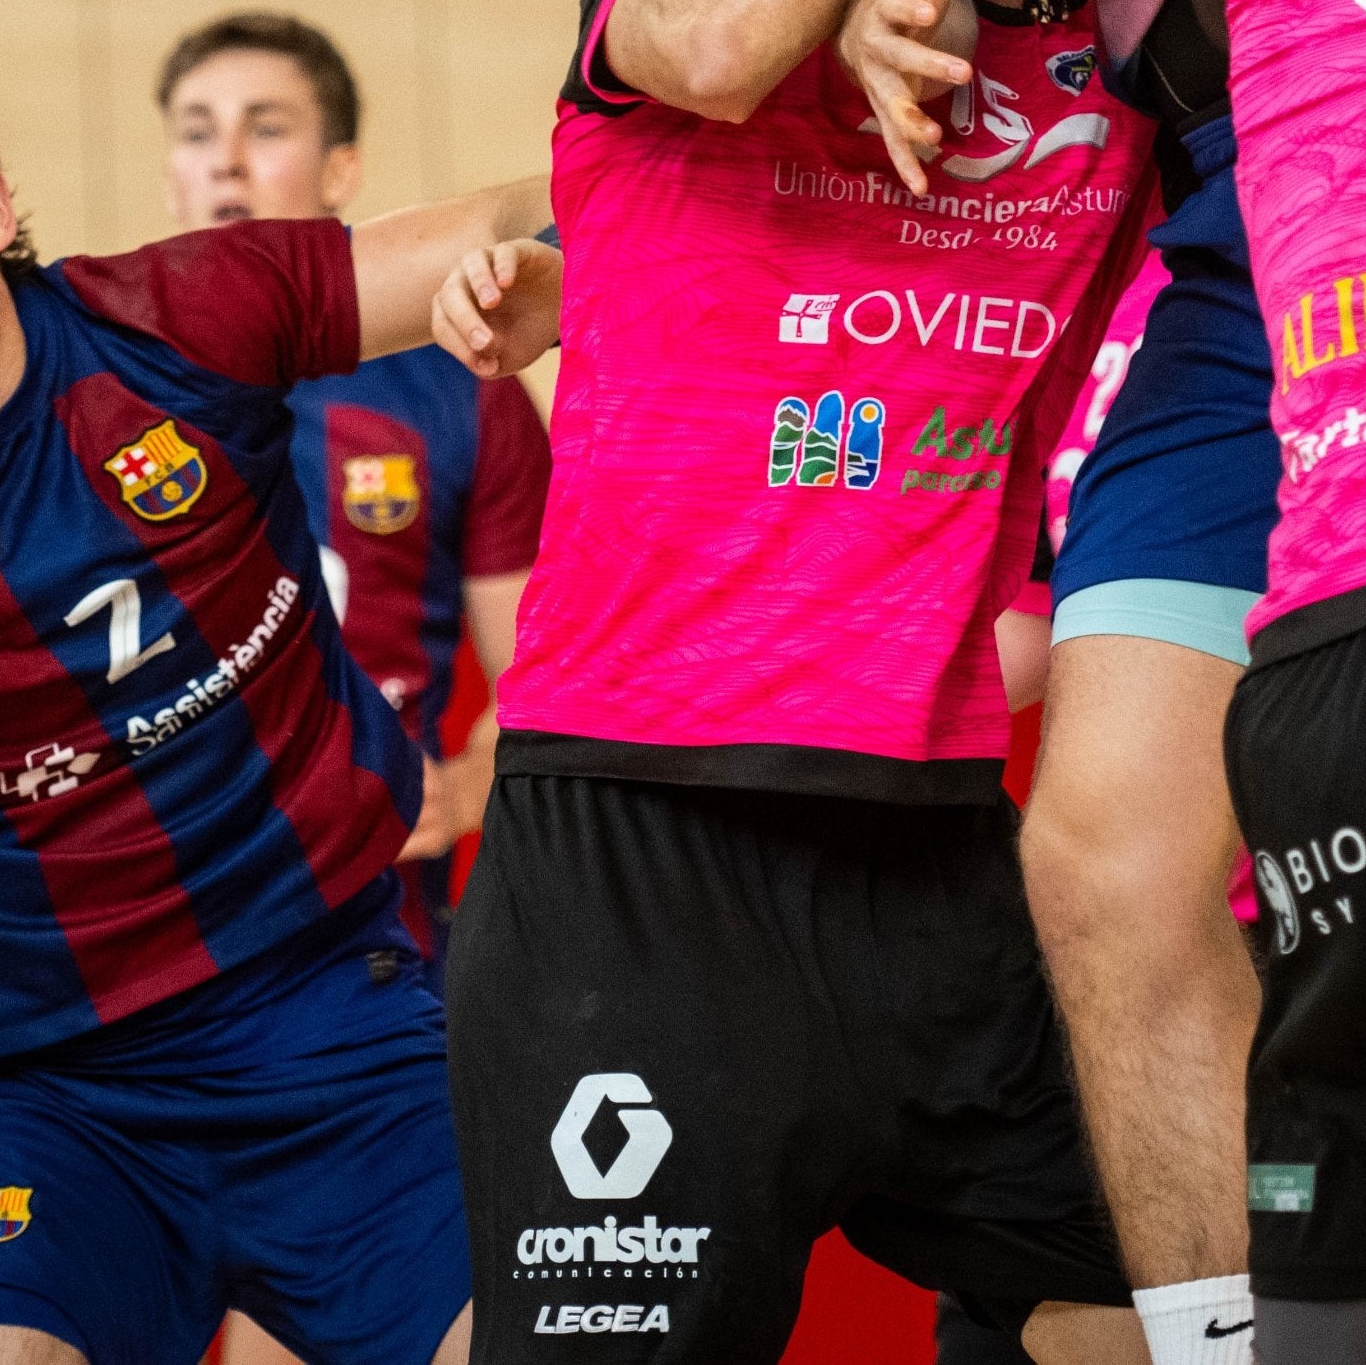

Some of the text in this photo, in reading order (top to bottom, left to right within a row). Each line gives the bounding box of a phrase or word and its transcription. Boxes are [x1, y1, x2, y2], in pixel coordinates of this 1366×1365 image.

[843, 290, 1072, 358] OVIED
[910, 404, 1013, 460] Astu
[63, 578, 177, 684] 2
[517, 1215, 712, 1265] cronistar
[534, 1304, 670, 1334] LEGEA
